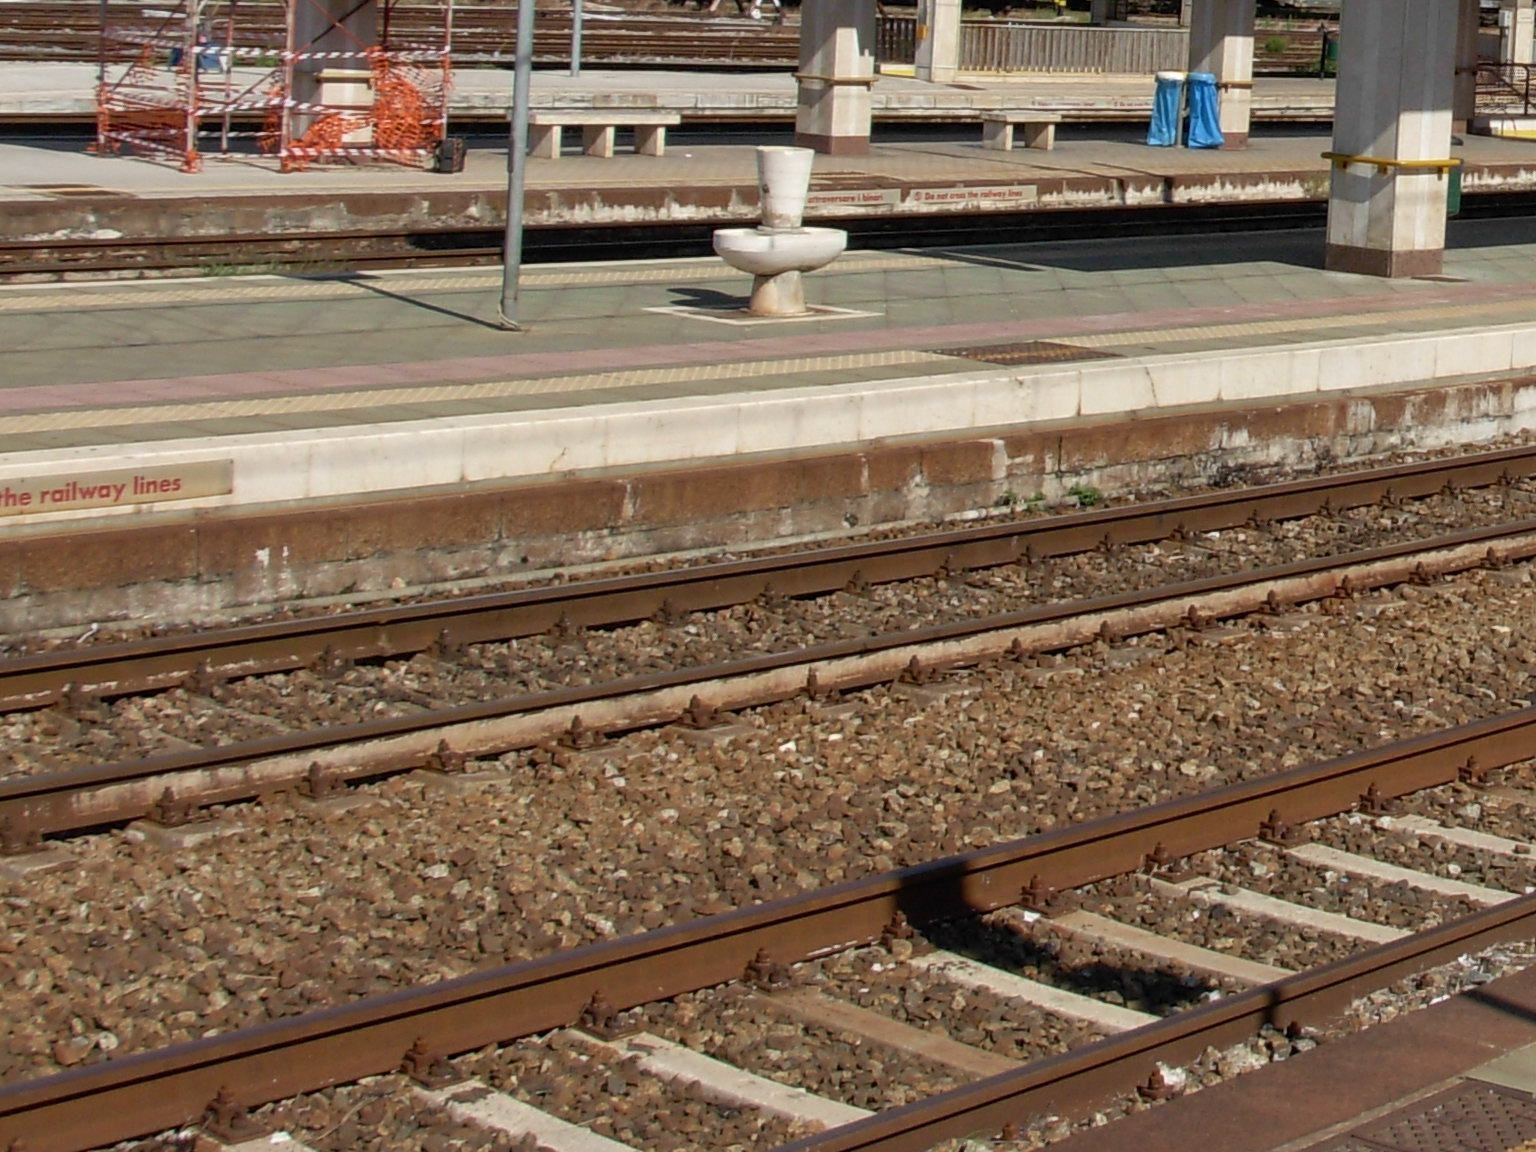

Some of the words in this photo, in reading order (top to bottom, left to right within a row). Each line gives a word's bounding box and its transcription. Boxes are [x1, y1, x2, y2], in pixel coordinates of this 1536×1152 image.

[925, 192, 935, 200] Do
[936, 192, 948, 200] not
[949, 192, 966, 200] cross
[980, 189, 1007, 199] railway
[1008, 189, 1023, 197] lines
[40, 481, 126, 504] railway
[133, 476, 182, 495] lines
